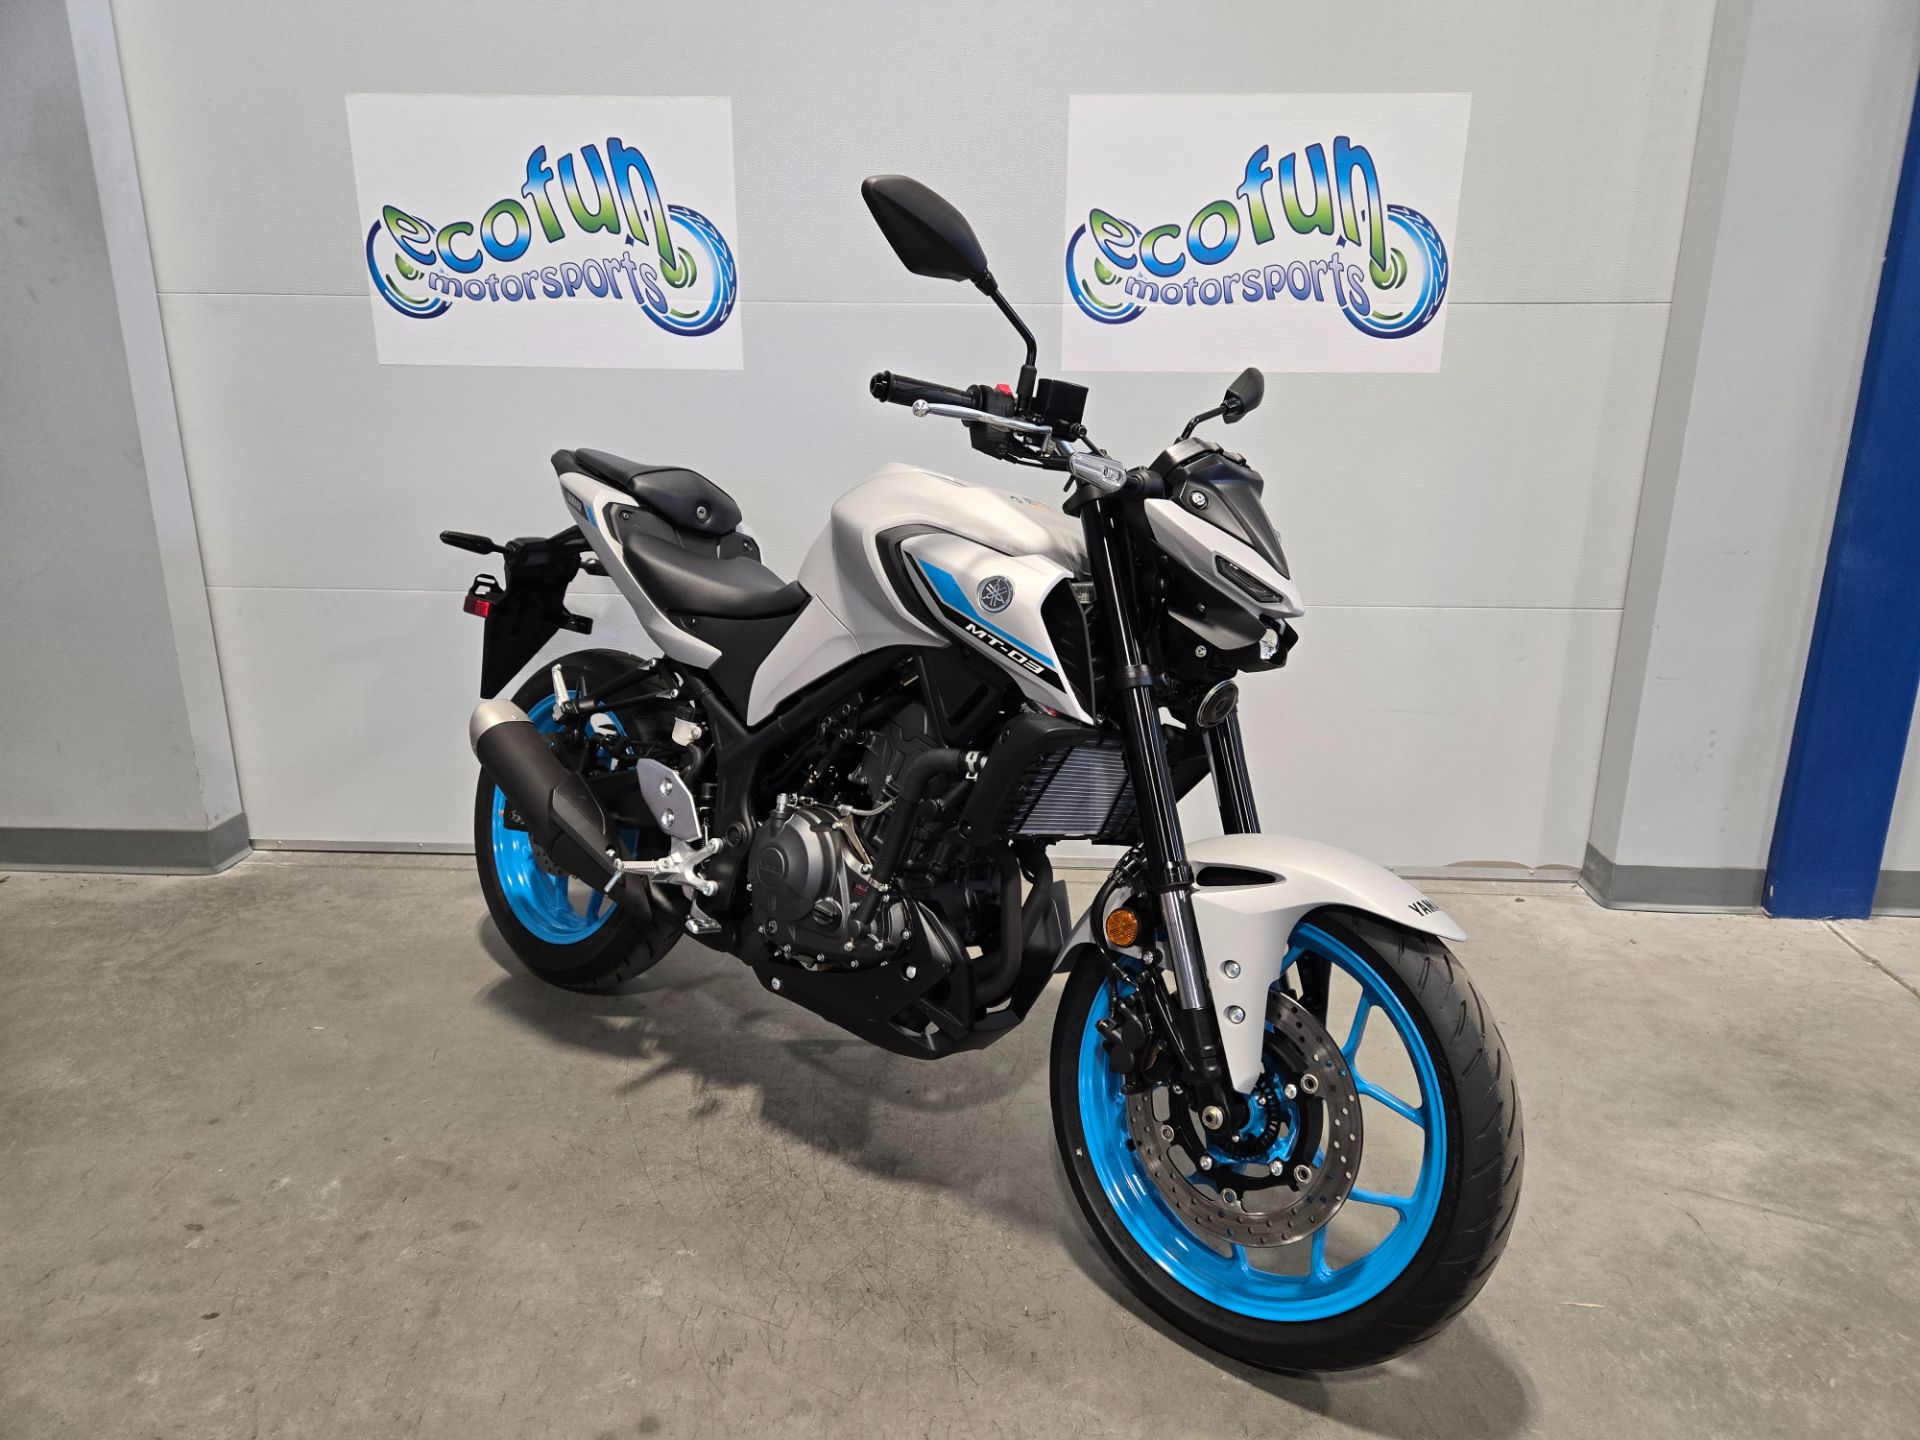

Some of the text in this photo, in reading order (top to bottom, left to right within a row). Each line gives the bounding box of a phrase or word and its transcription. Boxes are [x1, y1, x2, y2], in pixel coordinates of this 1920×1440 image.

[383, 137, 676, 273] ecofun
[1089, 135, 1386, 276] ecofun
[429, 251, 667, 314] motorsports
[1125, 251, 1371, 316] motorsports
[966, 623, 1045, 674] MT-03
